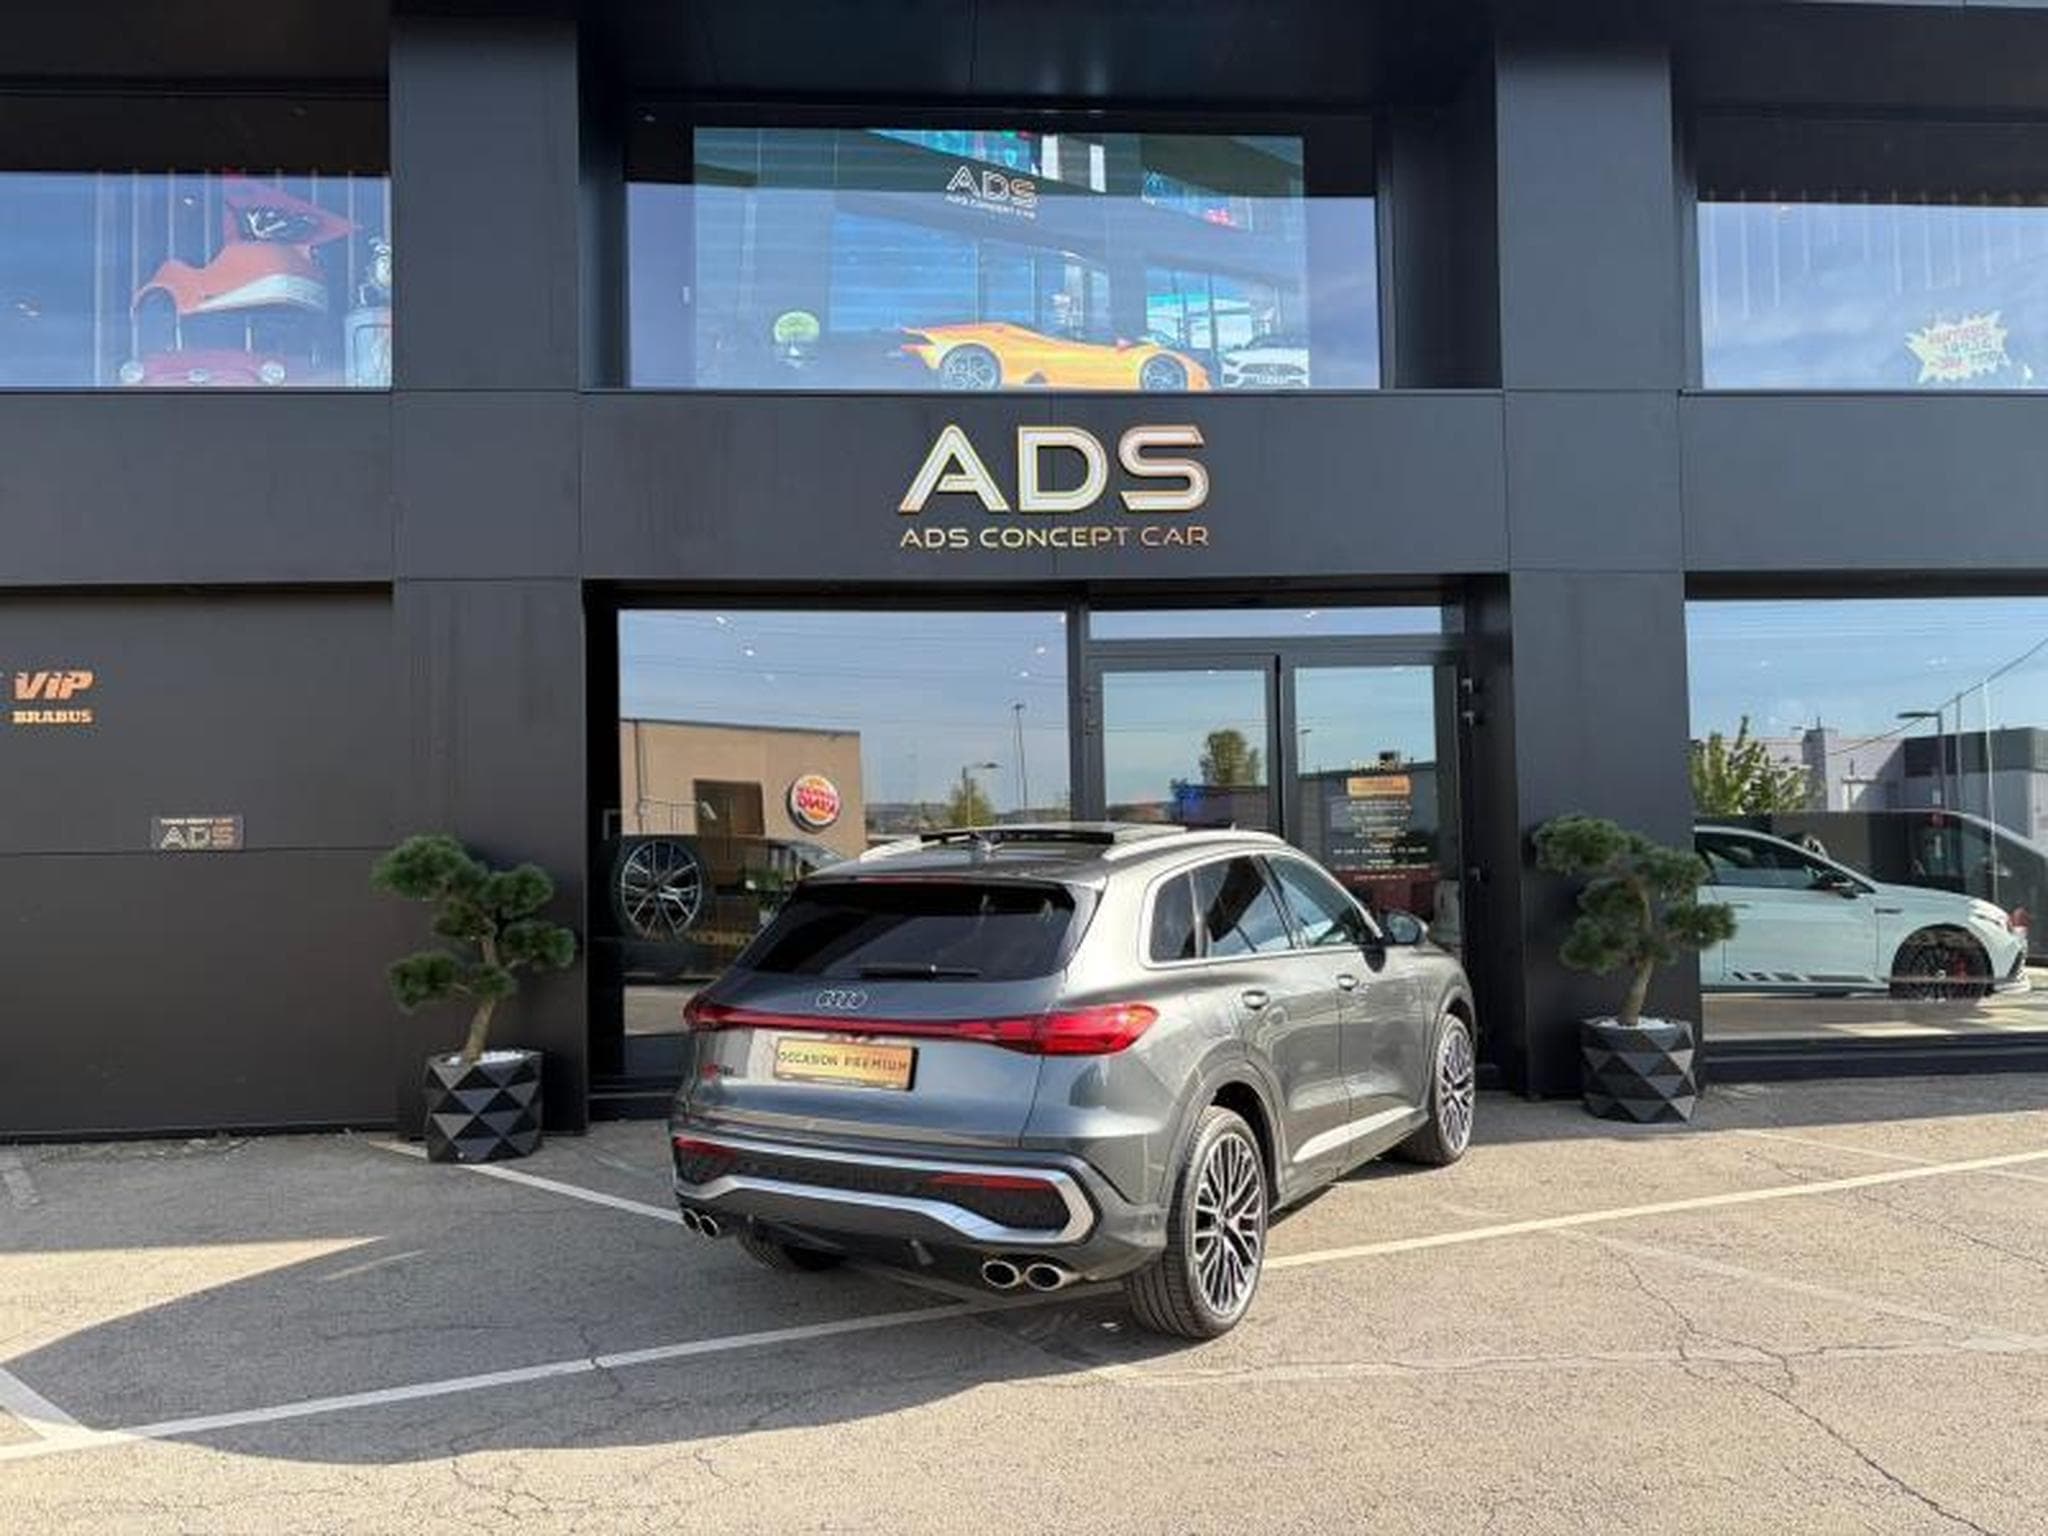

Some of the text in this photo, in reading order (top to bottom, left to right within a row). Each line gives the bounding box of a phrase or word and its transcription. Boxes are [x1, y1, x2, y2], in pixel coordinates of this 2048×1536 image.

[898, 424, 1210, 513] ADS
[900, 526, 1210, 549] ADS CONCEPT CAR
[12, 709, 93, 724] BRABUS
[160, 826, 235, 850] ADS
[844, 1056, 907, 1071] PREMIUM
